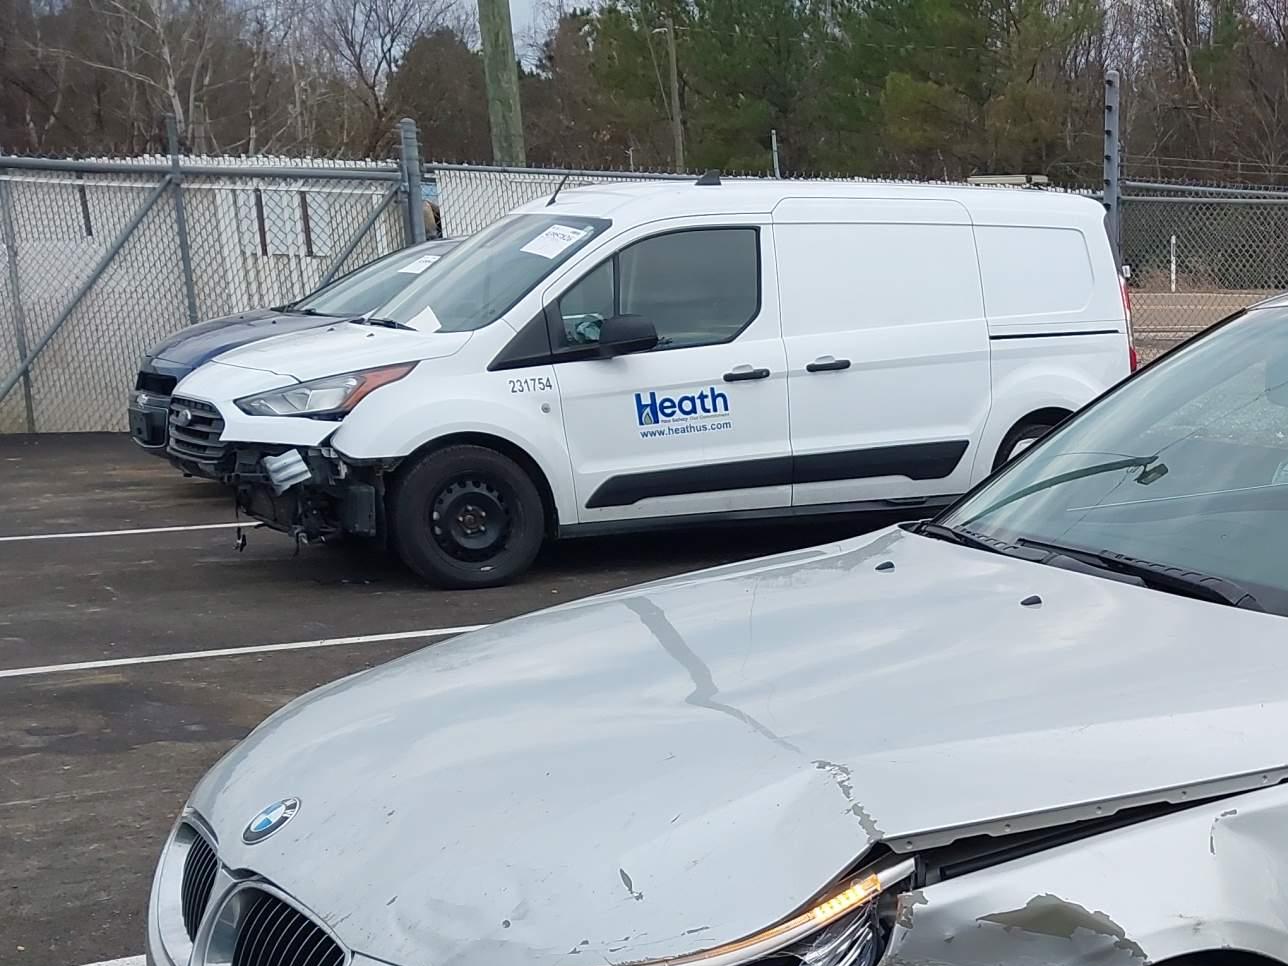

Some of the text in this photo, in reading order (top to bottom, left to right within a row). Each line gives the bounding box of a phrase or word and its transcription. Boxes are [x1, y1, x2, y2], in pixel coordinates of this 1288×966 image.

[508, 376, 553, 393] 231754
[634, 387, 729, 425] Heath
[640, 421, 732, 438] www.heathus.com
